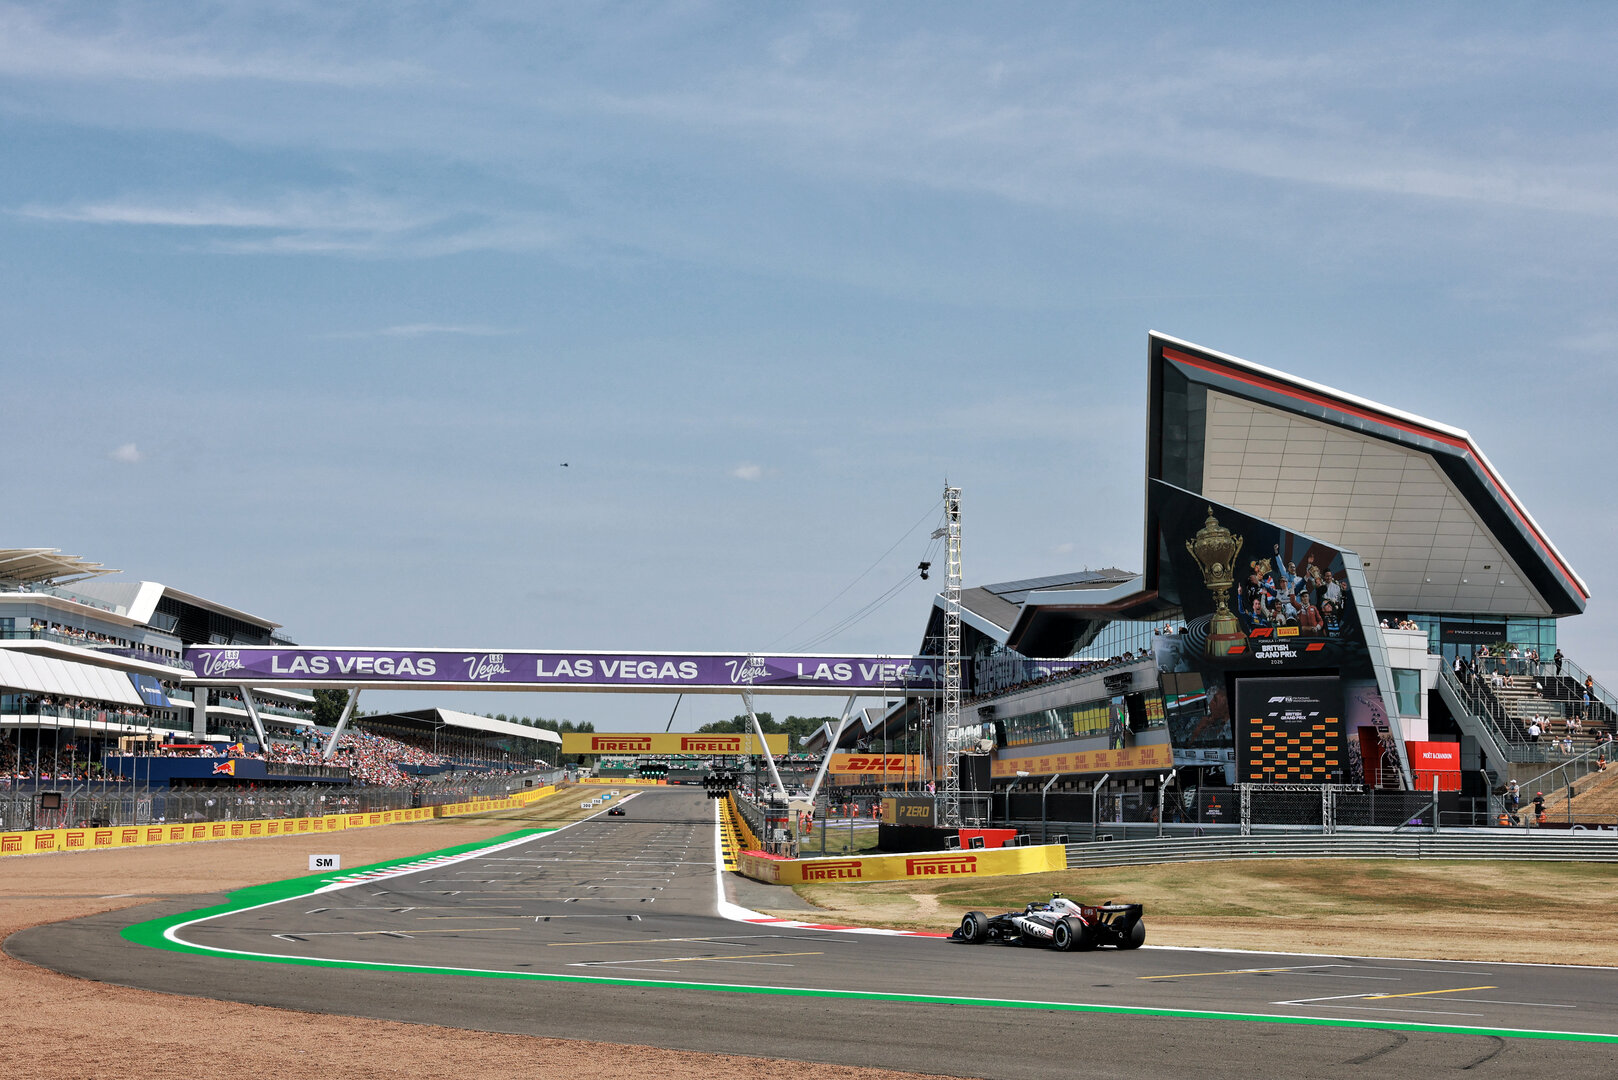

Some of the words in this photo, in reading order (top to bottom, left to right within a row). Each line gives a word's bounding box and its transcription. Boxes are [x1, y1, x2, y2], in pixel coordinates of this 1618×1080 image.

[225, 651, 239, 659] LAS
[490, 654, 503, 663] LAS
[1255, 651, 1279, 659] GRAND
[198, 651, 245, 677] Vegas
[272, 655, 329, 674] LAS
[335, 656, 436, 676] VEGAS
[463, 655, 510, 681] Vegas
[536, 659, 594, 677] LAS
[599, 659, 698, 679] VEGAS
[724, 660, 772, 683] Vegas
[797, 662, 853, 681] LAS
[858, 663, 950, 682] VEGAS
[591, 736, 652, 750] PIRELLI
[680, 737, 741, 751] PIRELLI
[847, 757, 906, 771] DHL
[899, 805, 906, 817] P
[906, 806, 930, 818] ZERO
[66, 832, 84, 847] PIRELLI
[95, 831, 112, 845] PIRELLI
[122, 829, 138, 844] PIRELLI
[147, 828, 162, 842] PIRELLI
[170, 827, 184, 840] PIRELLI
[192, 826, 206, 839] PIRELLI
[2, 836, 22, 852] PIRELLI
[35, 833, 55, 850] PIRELLI
[315, 858, 333, 867] SM
[906, 856, 977, 876] PIRELLI
[801, 861, 862, 881] PIRELLI
